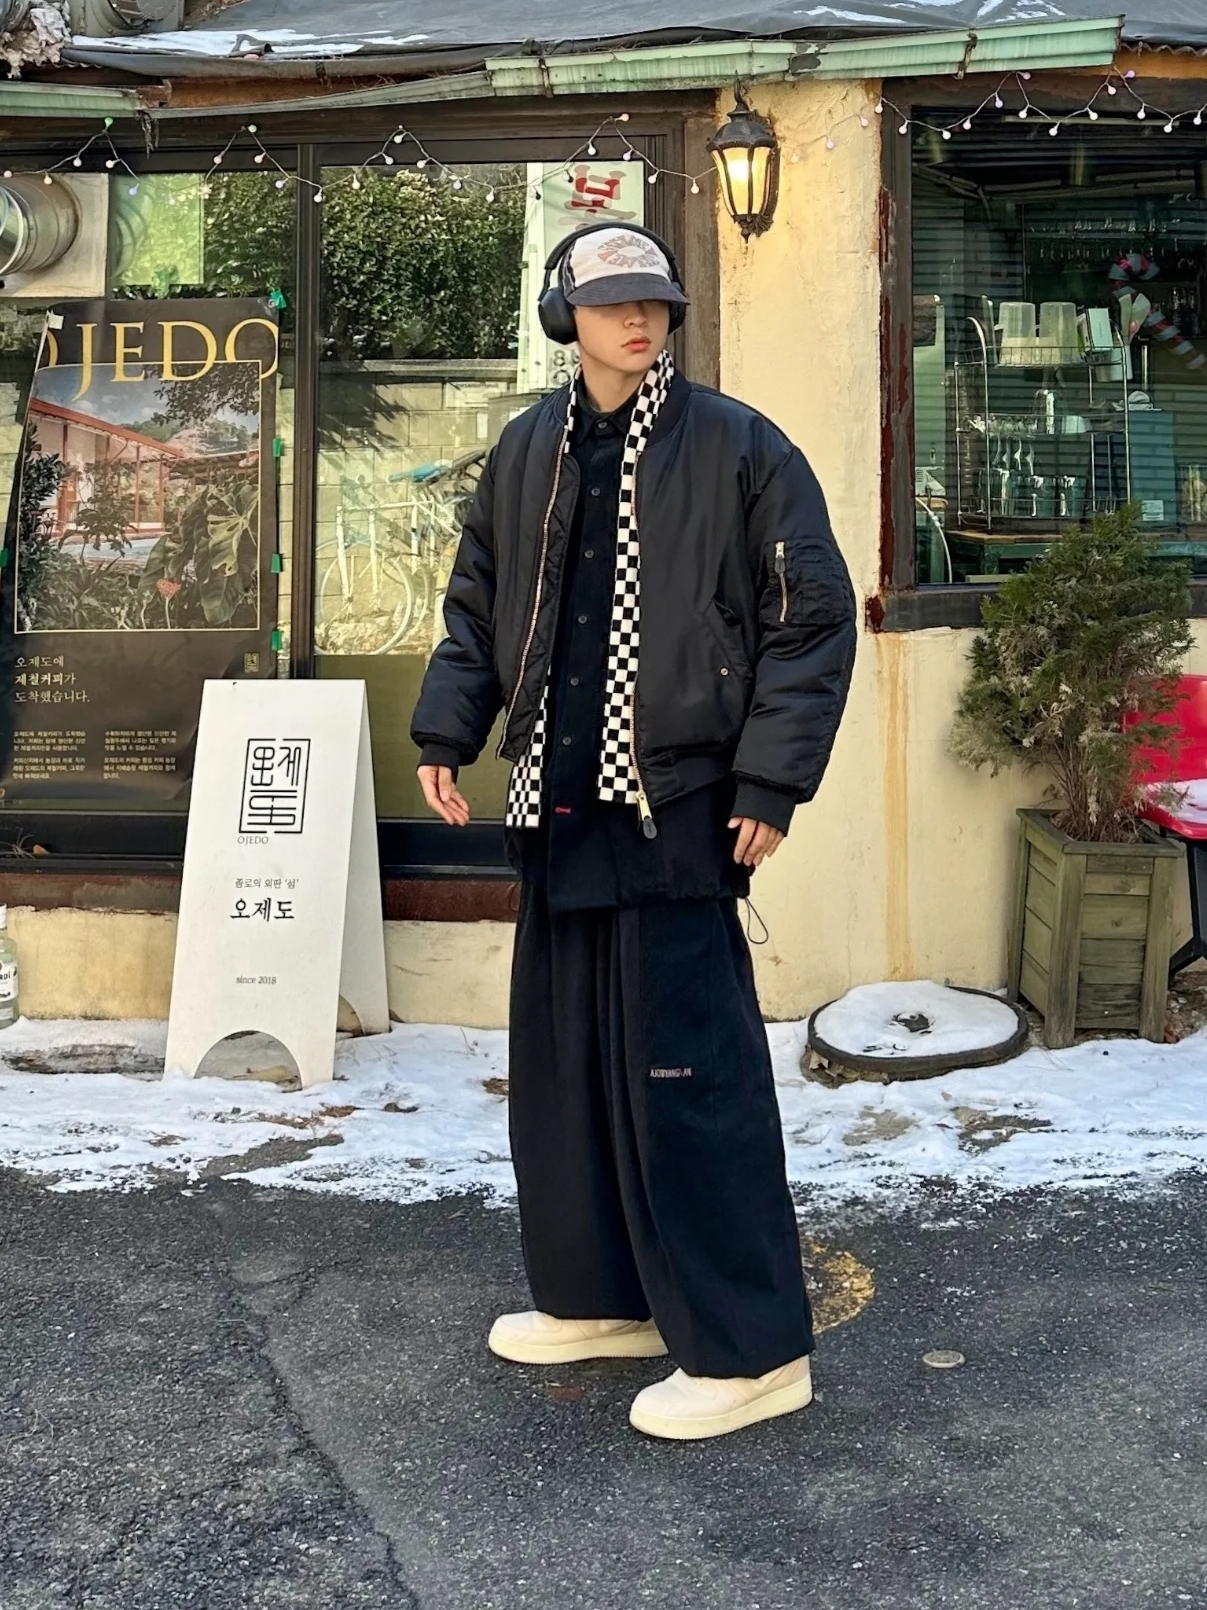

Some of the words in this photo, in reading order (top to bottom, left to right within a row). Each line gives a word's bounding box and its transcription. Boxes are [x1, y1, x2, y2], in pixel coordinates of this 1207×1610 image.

[46, 318, 278, 401] JEDO
[14, 655, 64, 668] 오제도에
[14, 672, 76, 686] 제철커피가
[14, 690, 91, 703] 도착했습니다.
[237, 835, 269, 846] OJEDO
[235, 878, 262, 889] 종로의
[264, 878, 282, 889] 외딴
[230, 897, 295, 922] 오제도
[236, 975, 256, 984] since
[258, 976, 277, 985] 2018
